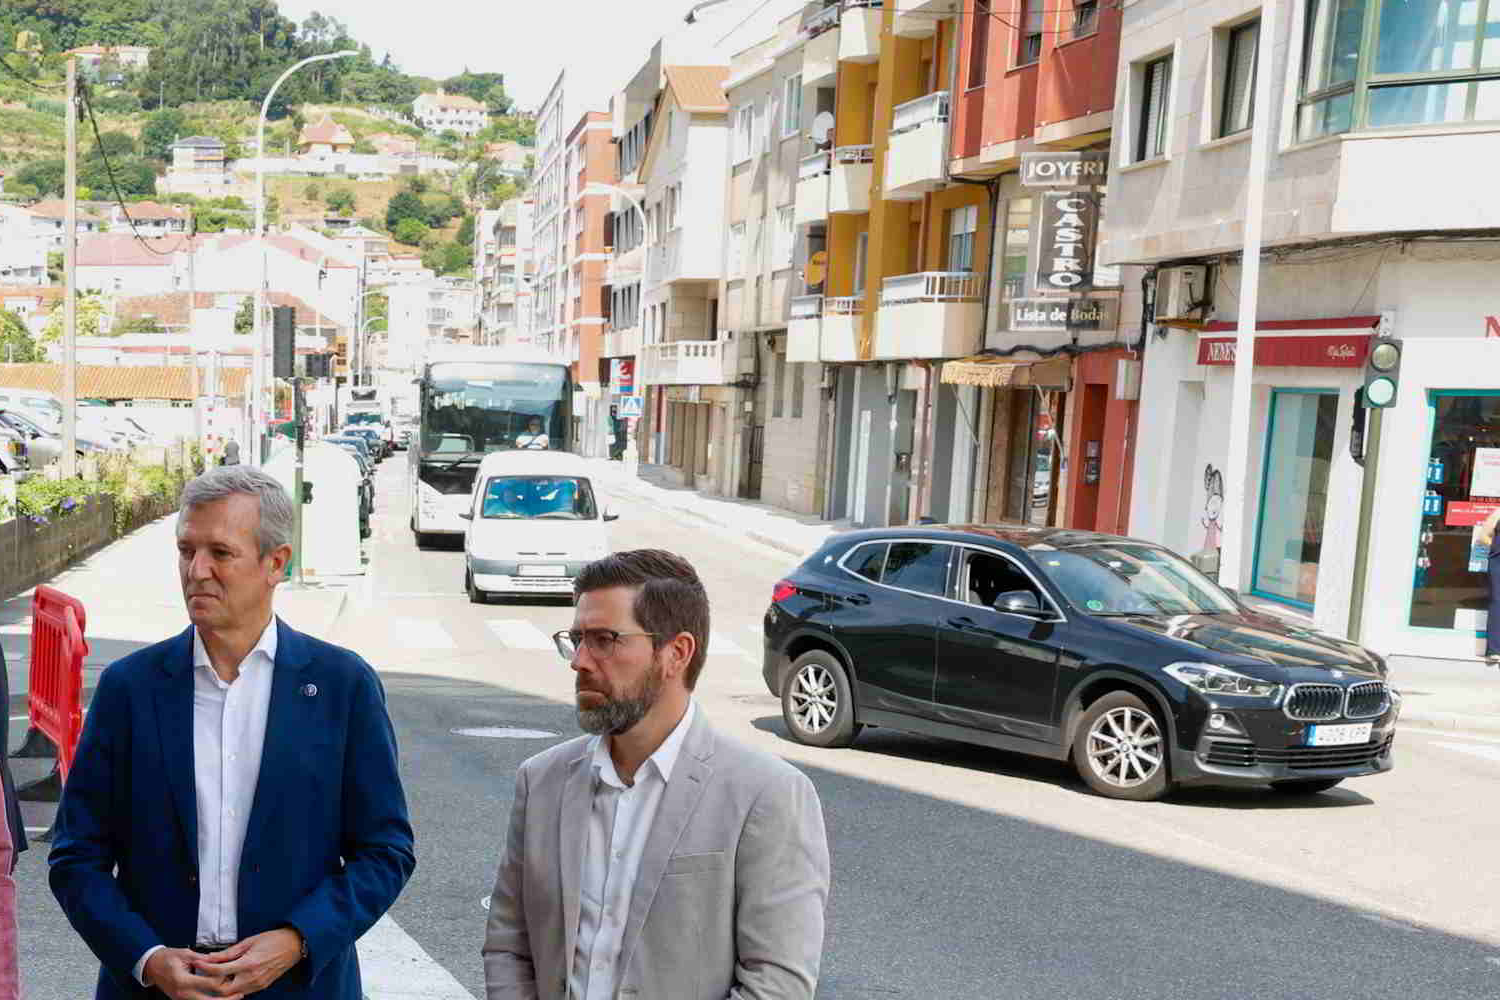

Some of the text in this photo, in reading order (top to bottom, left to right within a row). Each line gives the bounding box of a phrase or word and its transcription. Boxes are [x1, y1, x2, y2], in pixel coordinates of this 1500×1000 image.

[1028, 160, 1108, 178] JOYERI
[1049, 198, 1087, 287] CASTRO
[1016, 308, 1046, 321] Lista
[1050, 307, 1067, 321] de
